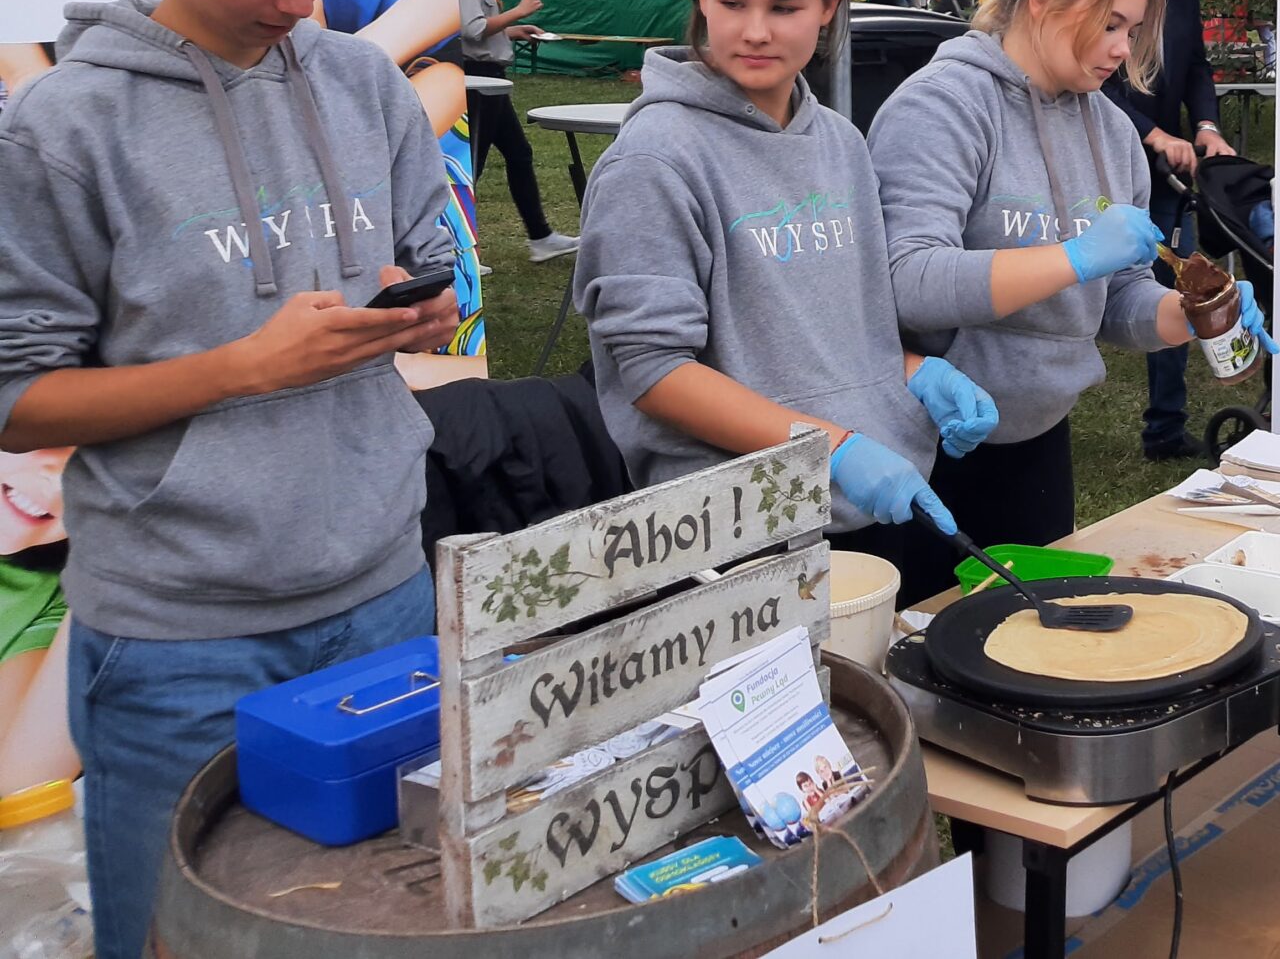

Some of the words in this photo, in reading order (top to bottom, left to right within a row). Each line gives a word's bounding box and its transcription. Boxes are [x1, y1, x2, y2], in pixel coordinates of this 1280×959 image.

[530, 620, 715, 728] Witamy
[731, 595, 781, 643] na
[746, 666, 779, 693] Fundacja
